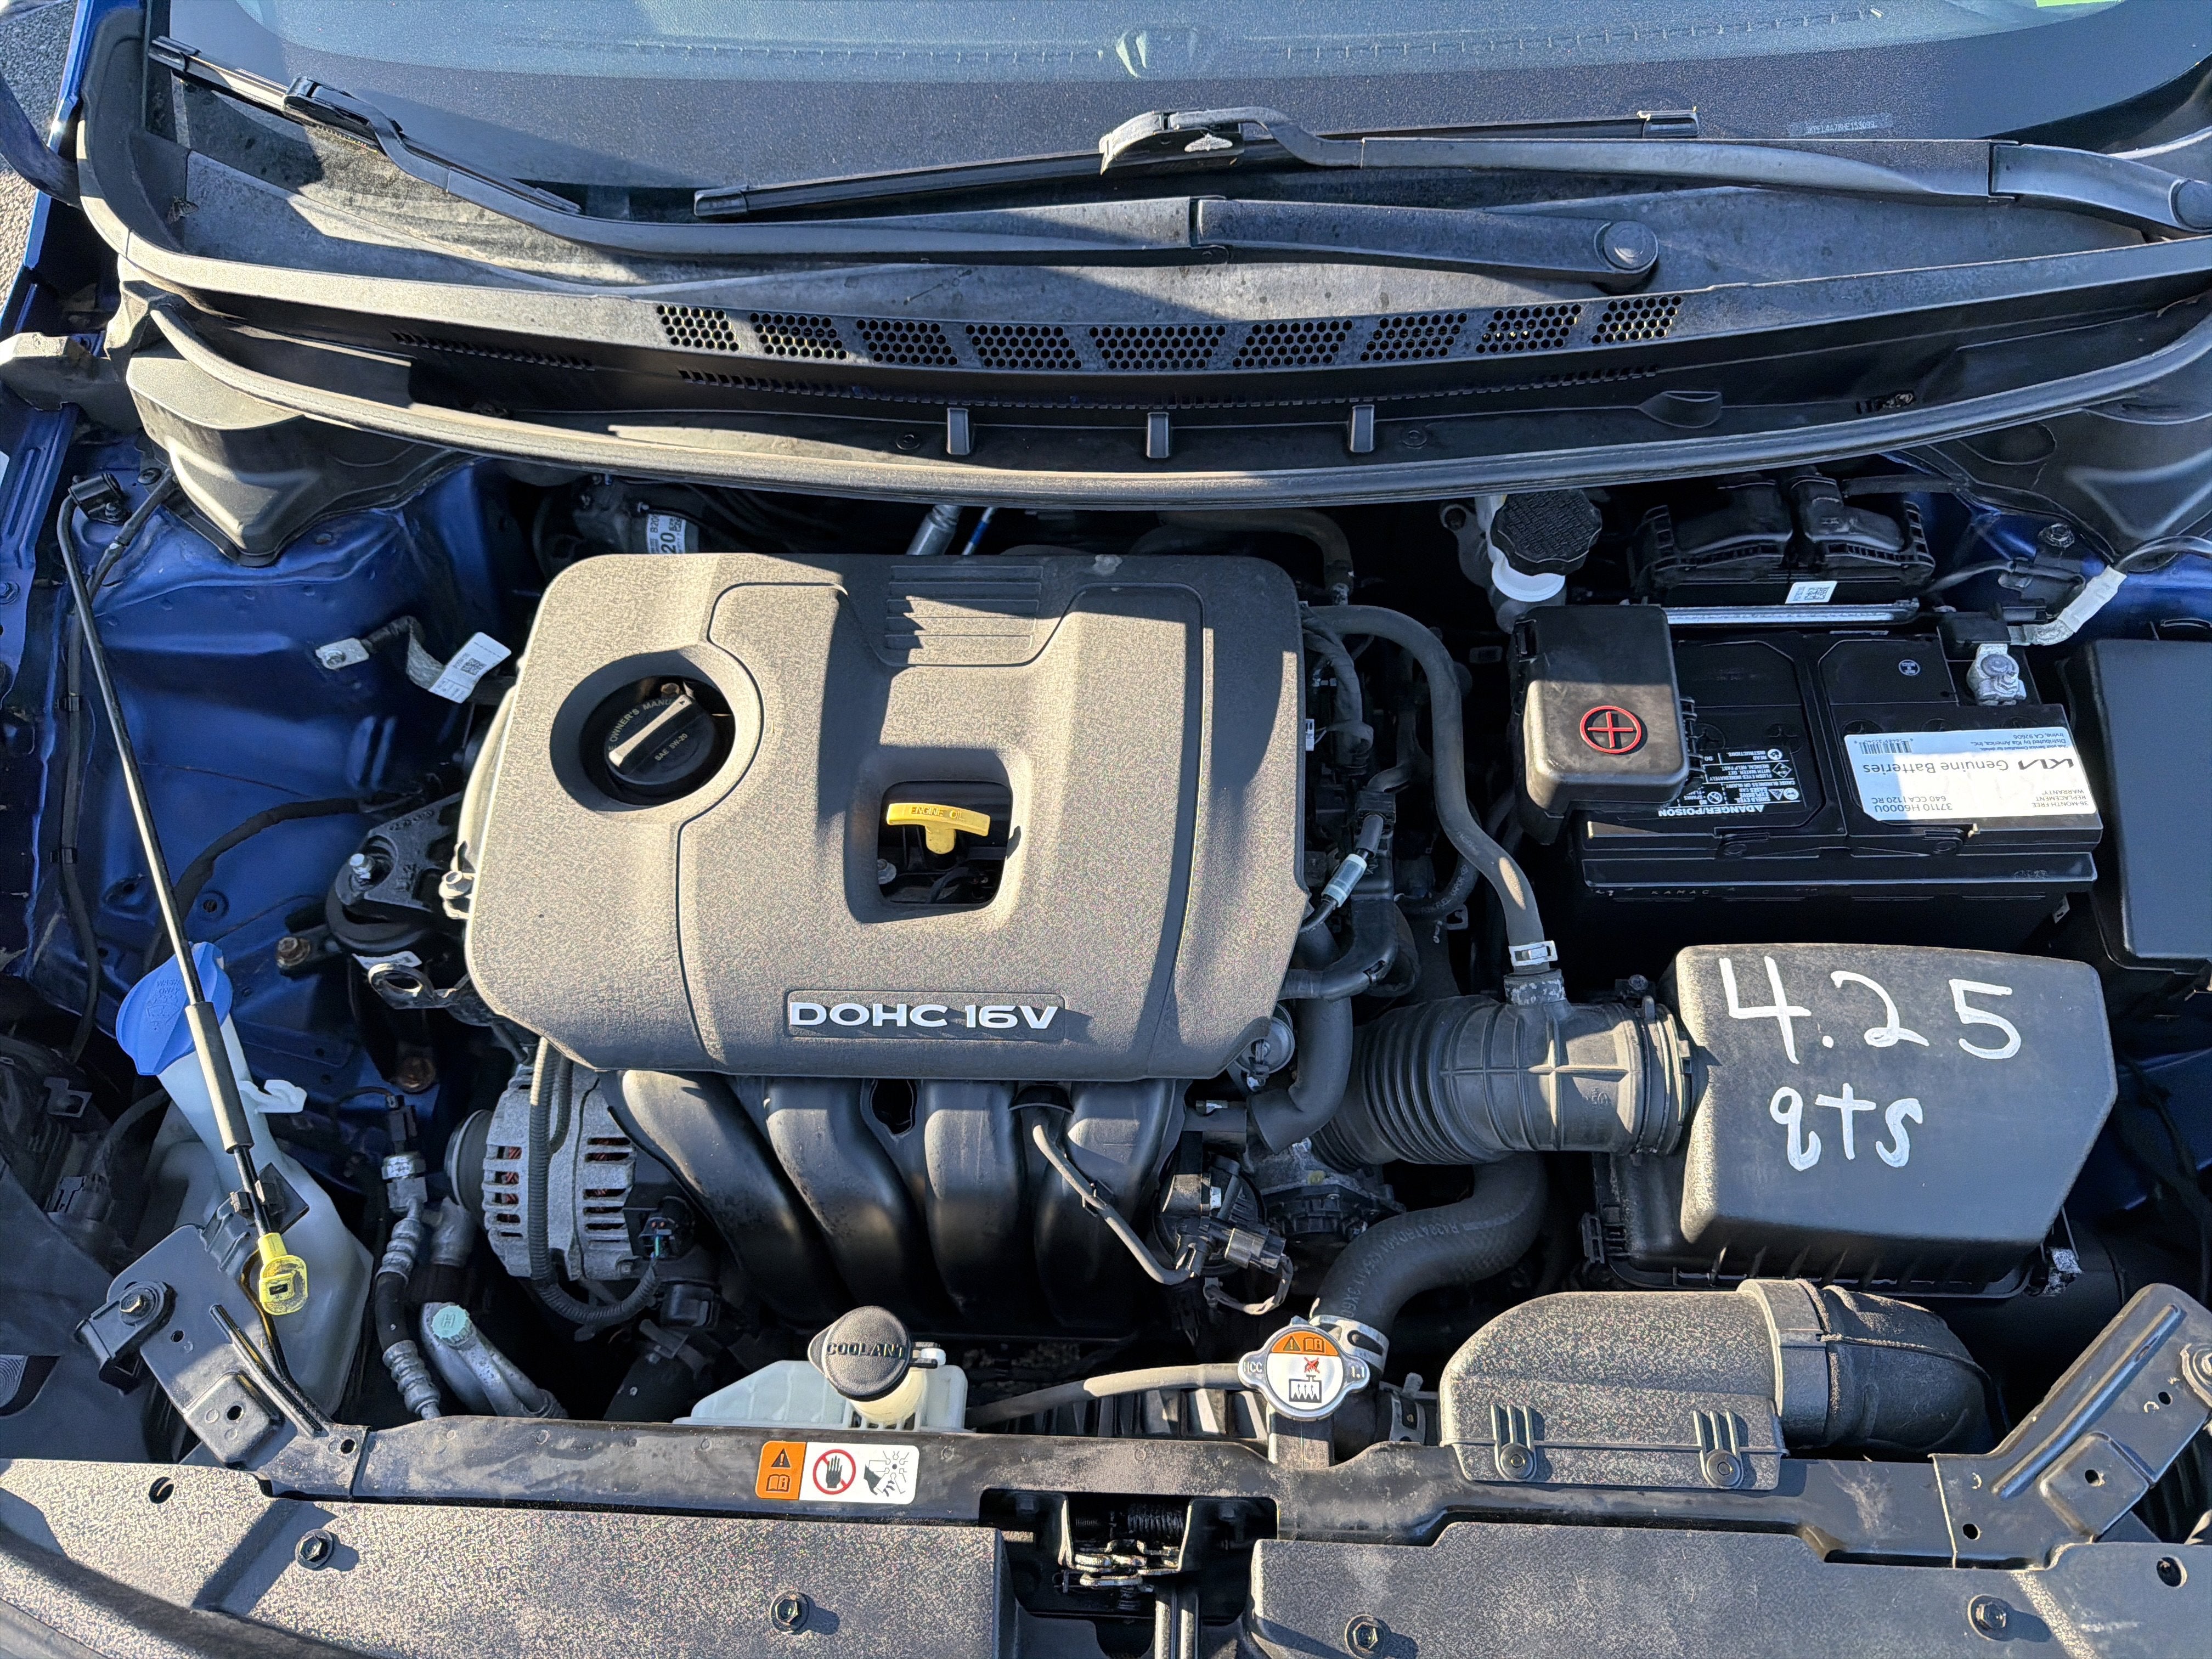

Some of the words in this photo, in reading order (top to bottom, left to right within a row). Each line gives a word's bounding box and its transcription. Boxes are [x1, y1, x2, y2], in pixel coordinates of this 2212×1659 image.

[610, 708, 640, 742] OWNER'S
[642, 698, 675, 710] MANU
[654, 748, 670, 761] SAE
[669, 733, 688, 749] 5W-20
[1863, 763, 1936, 775] Batteries
[1940, 760, 2008, 772] Genuine
[911, 806, 944, 816] ENGINE
[949, 810, 964, 820] OIL
[1658, 805, 1756, 816] DANGER/POISON
[789, 1001, 949, 1029] DOHC
[965, 1004, 1058, 1030] 16V
[827, 1342, 904, 1358] COOLANT
[1351, 1365, 1365, 1379] 1.1
